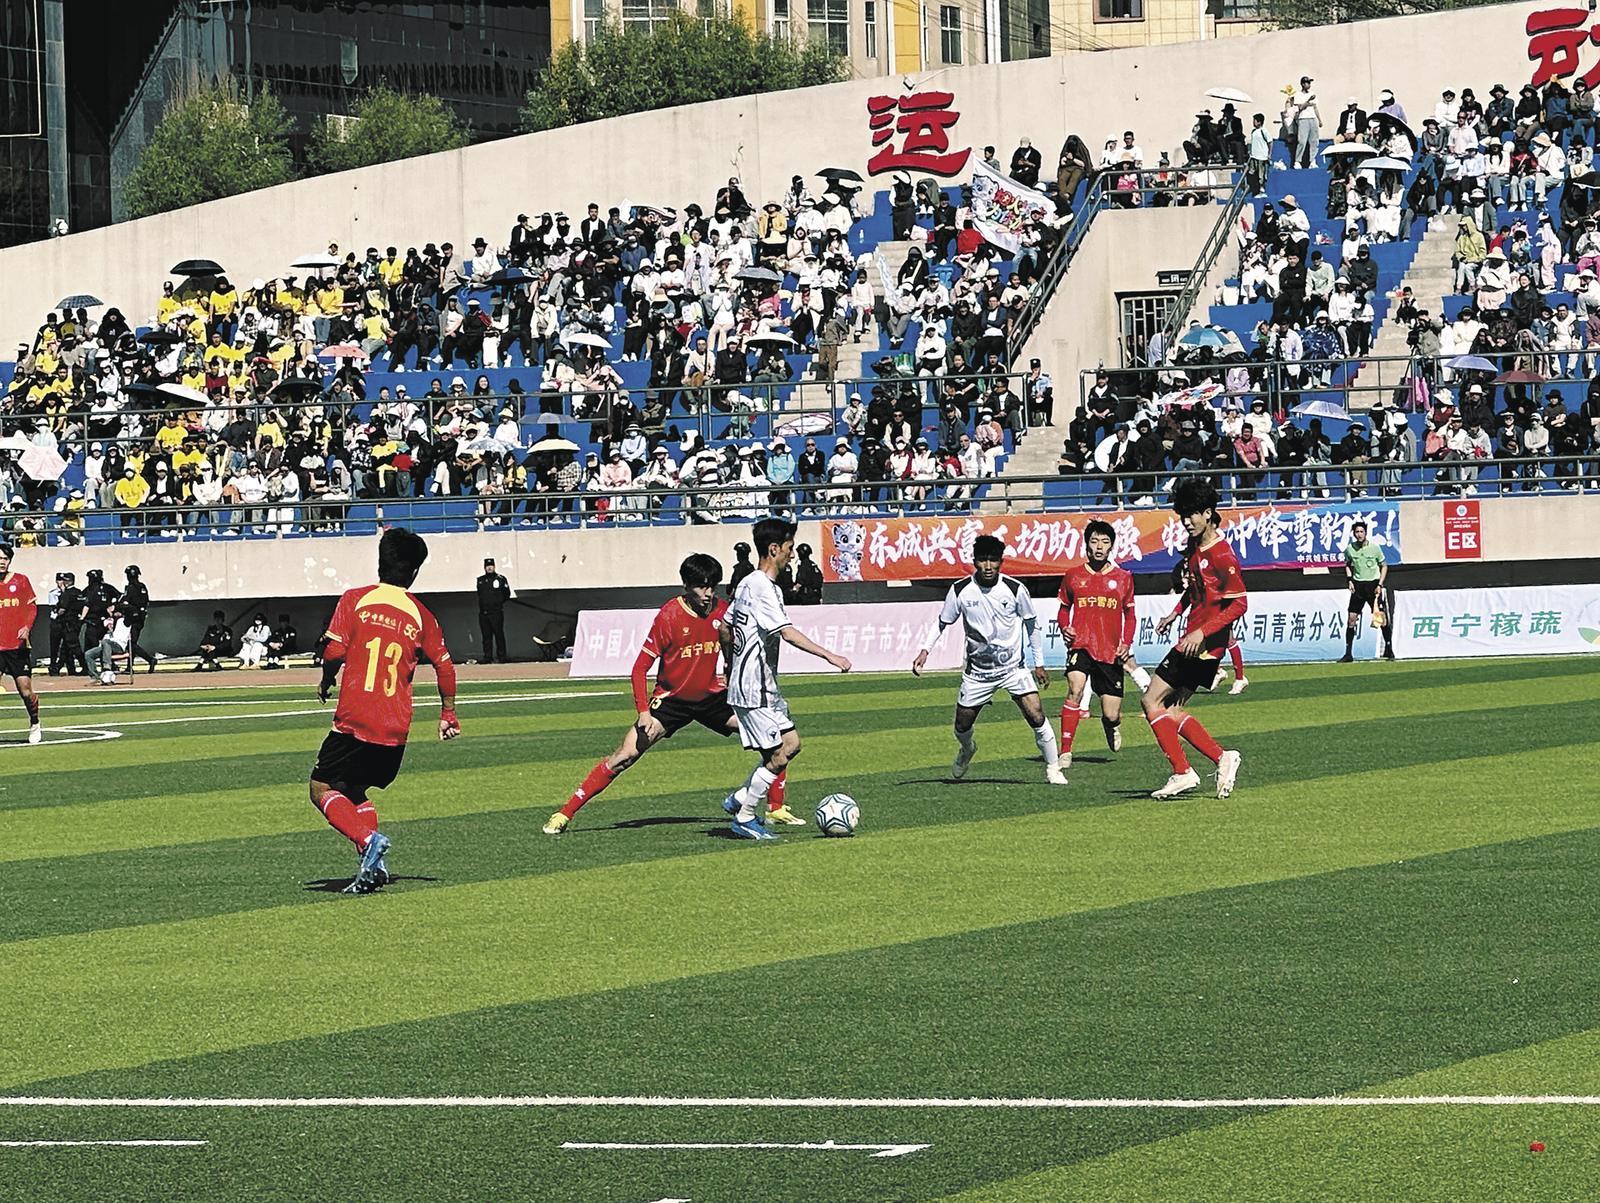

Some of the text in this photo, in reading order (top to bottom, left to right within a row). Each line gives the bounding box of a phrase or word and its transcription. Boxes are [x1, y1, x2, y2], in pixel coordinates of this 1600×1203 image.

[867, 91, 972, 178] 运
[1448, 532, 1477, 549] E区
[404, 623, 420, 640] 5G
[364, 637, 403, 697] 13
